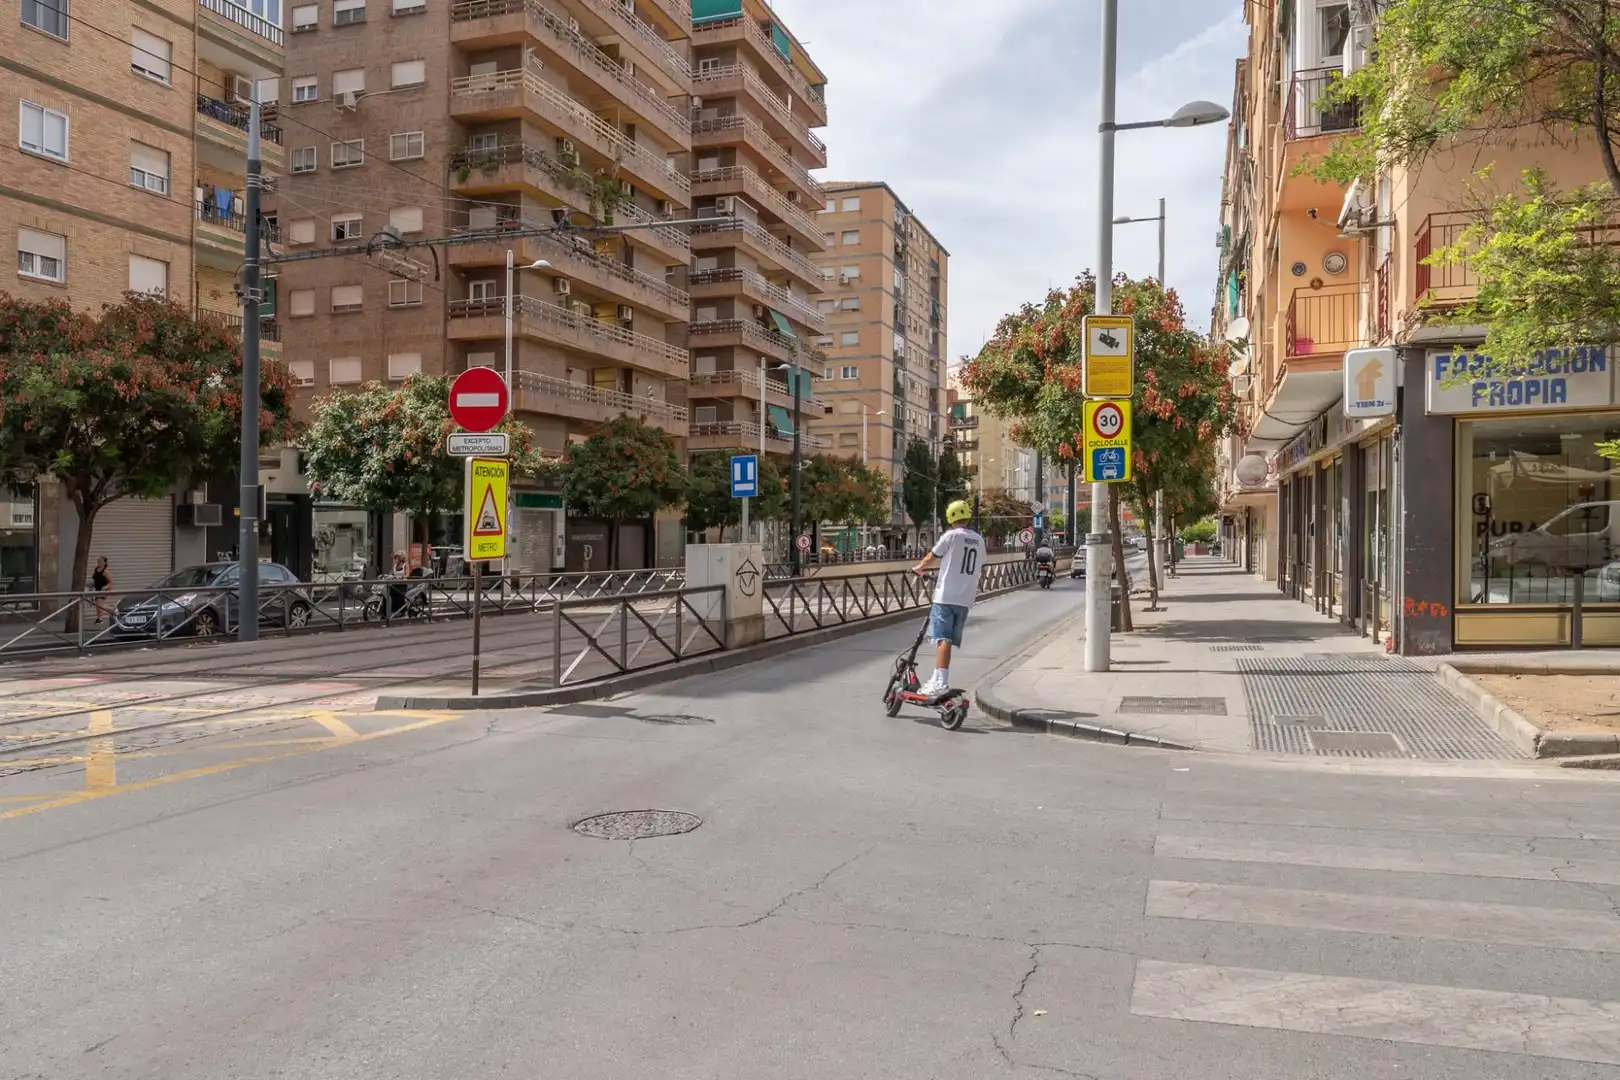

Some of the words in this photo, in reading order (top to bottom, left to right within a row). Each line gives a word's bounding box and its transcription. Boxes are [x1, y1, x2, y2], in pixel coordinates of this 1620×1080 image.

[1472, 378, 1567, 408] PROPIA
[1100, 415, 1118, 427] 30
[475, 465, 505, 478] ATENCIÓN
[478, 543, 497, 552] METRO
[960, 547, 977, 575] 10
